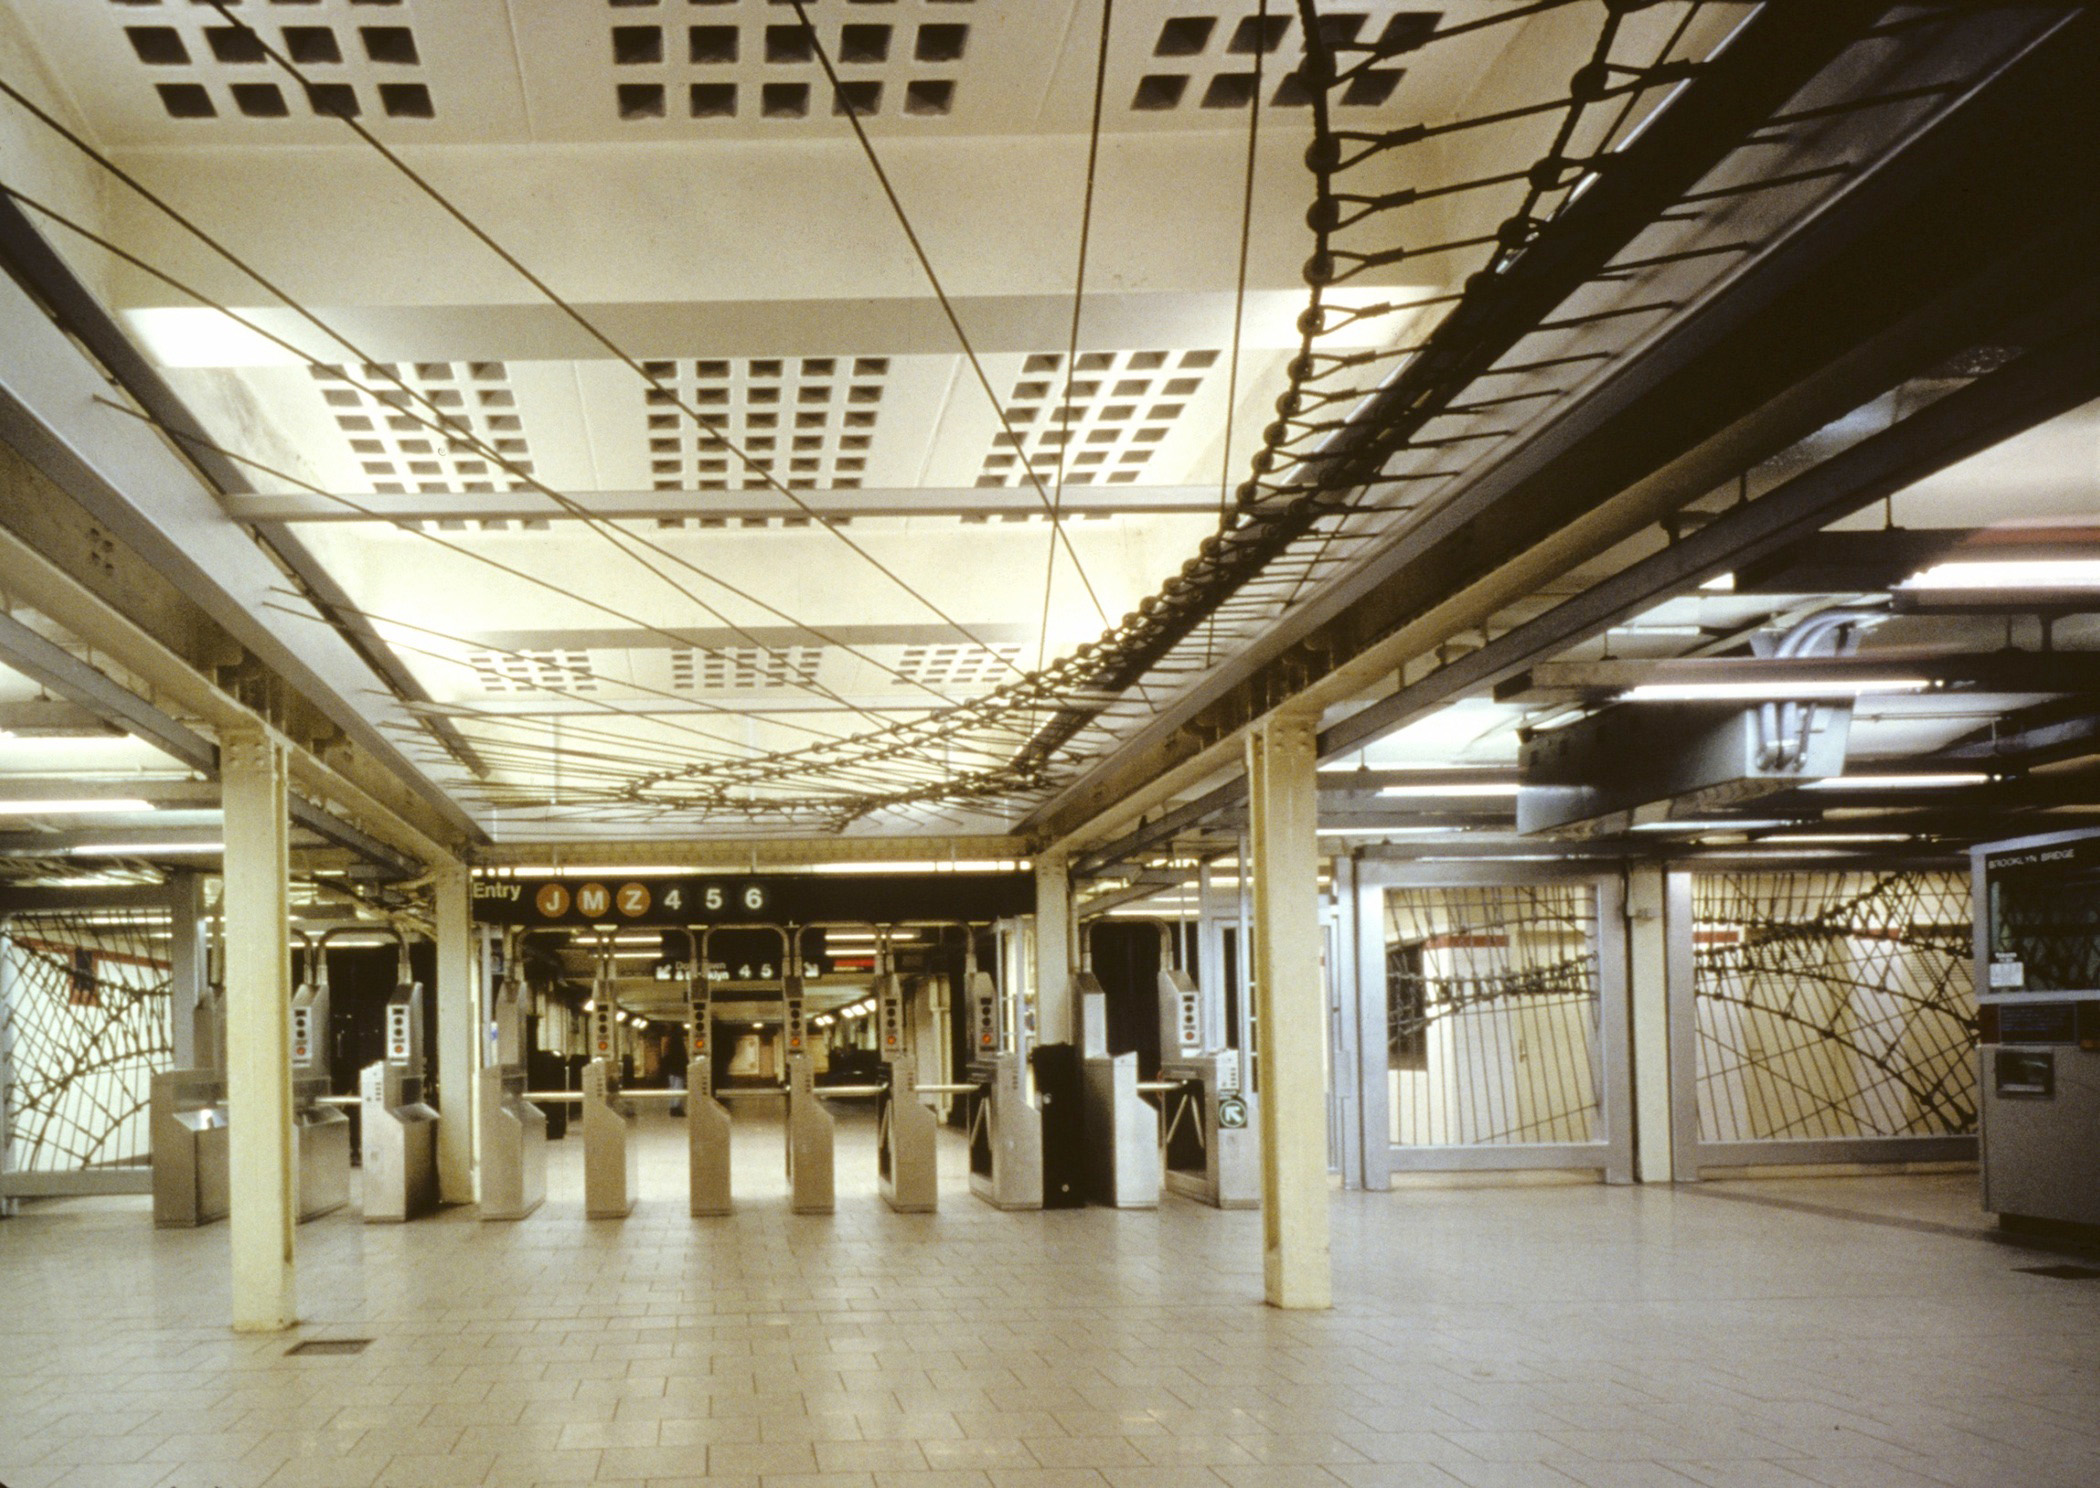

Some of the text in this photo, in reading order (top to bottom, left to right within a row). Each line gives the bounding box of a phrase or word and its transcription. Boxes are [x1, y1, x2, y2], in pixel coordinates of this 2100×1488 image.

[1988, 849, 2074, 869] BROOKLYN BRIDGE
[472, 882, 763, 911] Entry J M Z 4 5 6
[738, 964, 773, 978] 4 5
